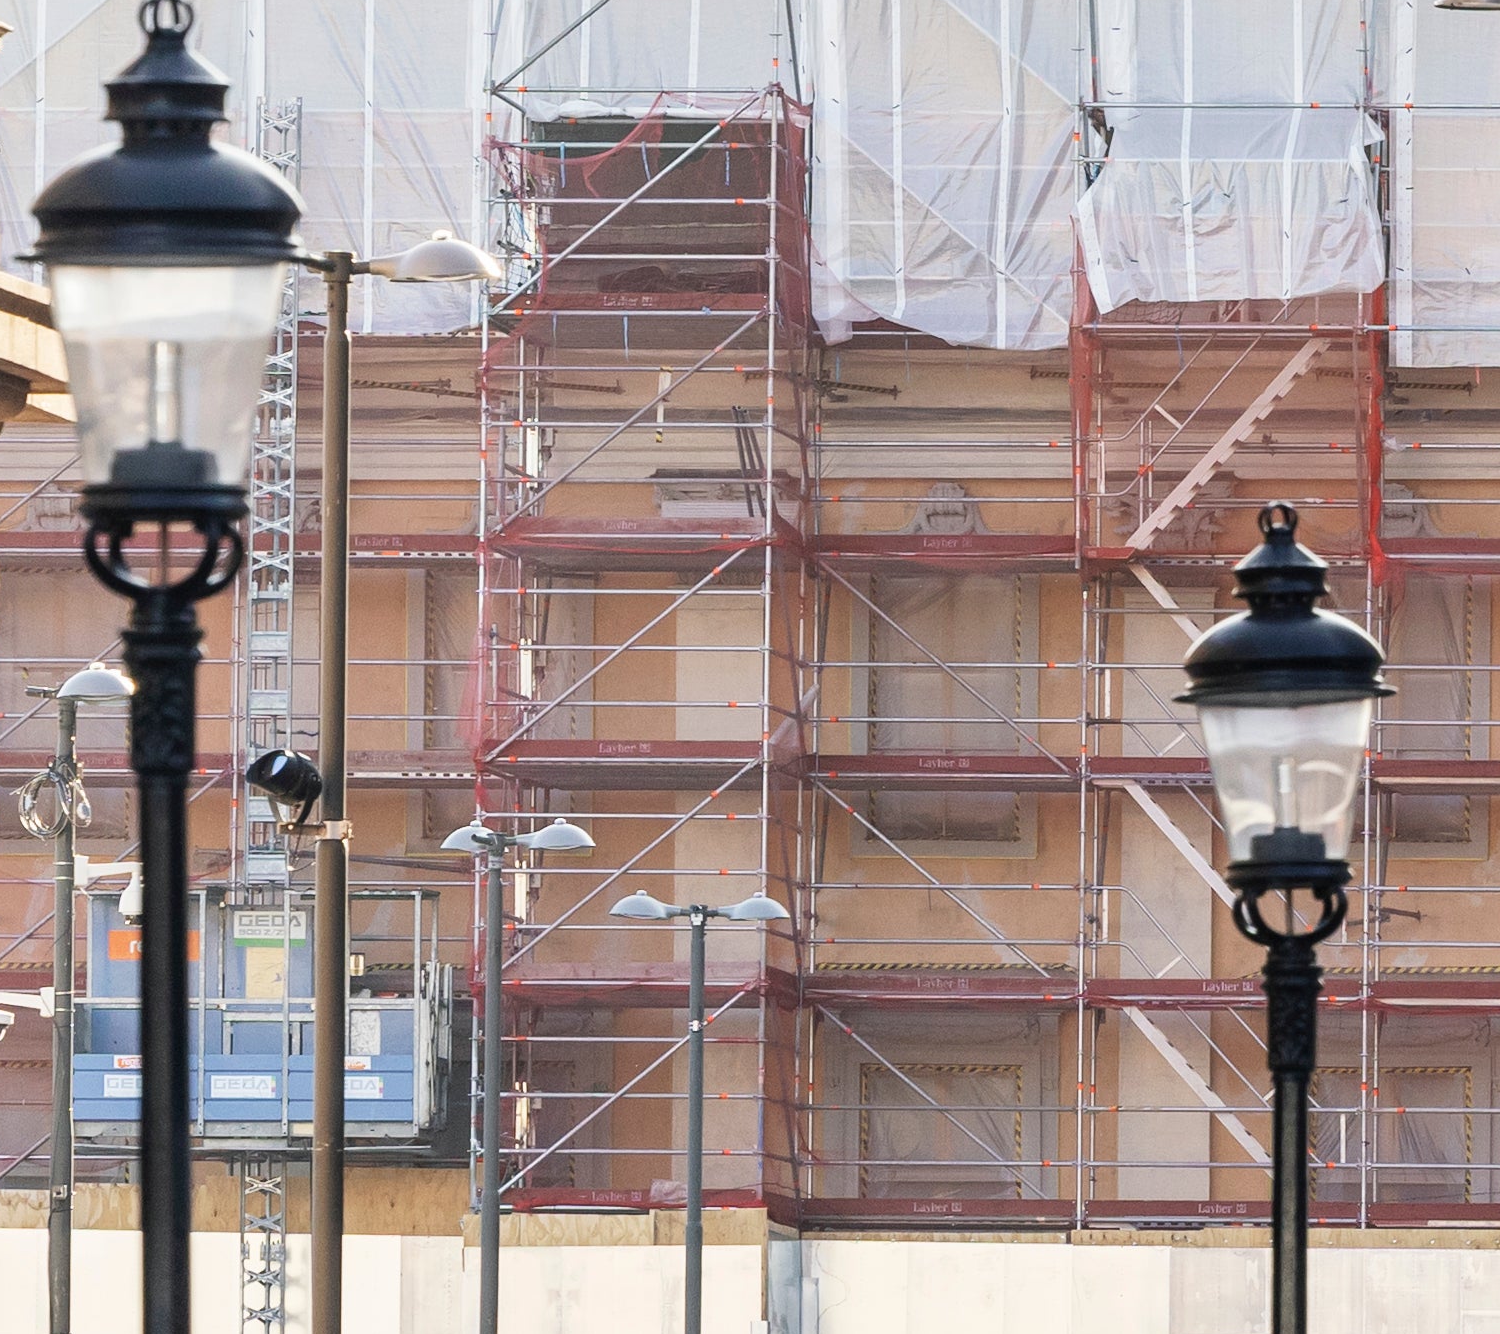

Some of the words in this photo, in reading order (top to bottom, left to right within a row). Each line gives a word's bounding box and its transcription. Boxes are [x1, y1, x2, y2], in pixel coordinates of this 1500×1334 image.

[598, 742, 637, 754] Layher
[918, 758, 955, 769] Layher
[238, 915, 302, 927] GEDA
[1202, 981, 1239, 993] Layher
[107, 1078, 142, 1089] GED
[213, 1077, 269, 1090] GEDA
[345, 1079, 377, 1090] DA
[1198, 1204, 1232, 1215] Layher
